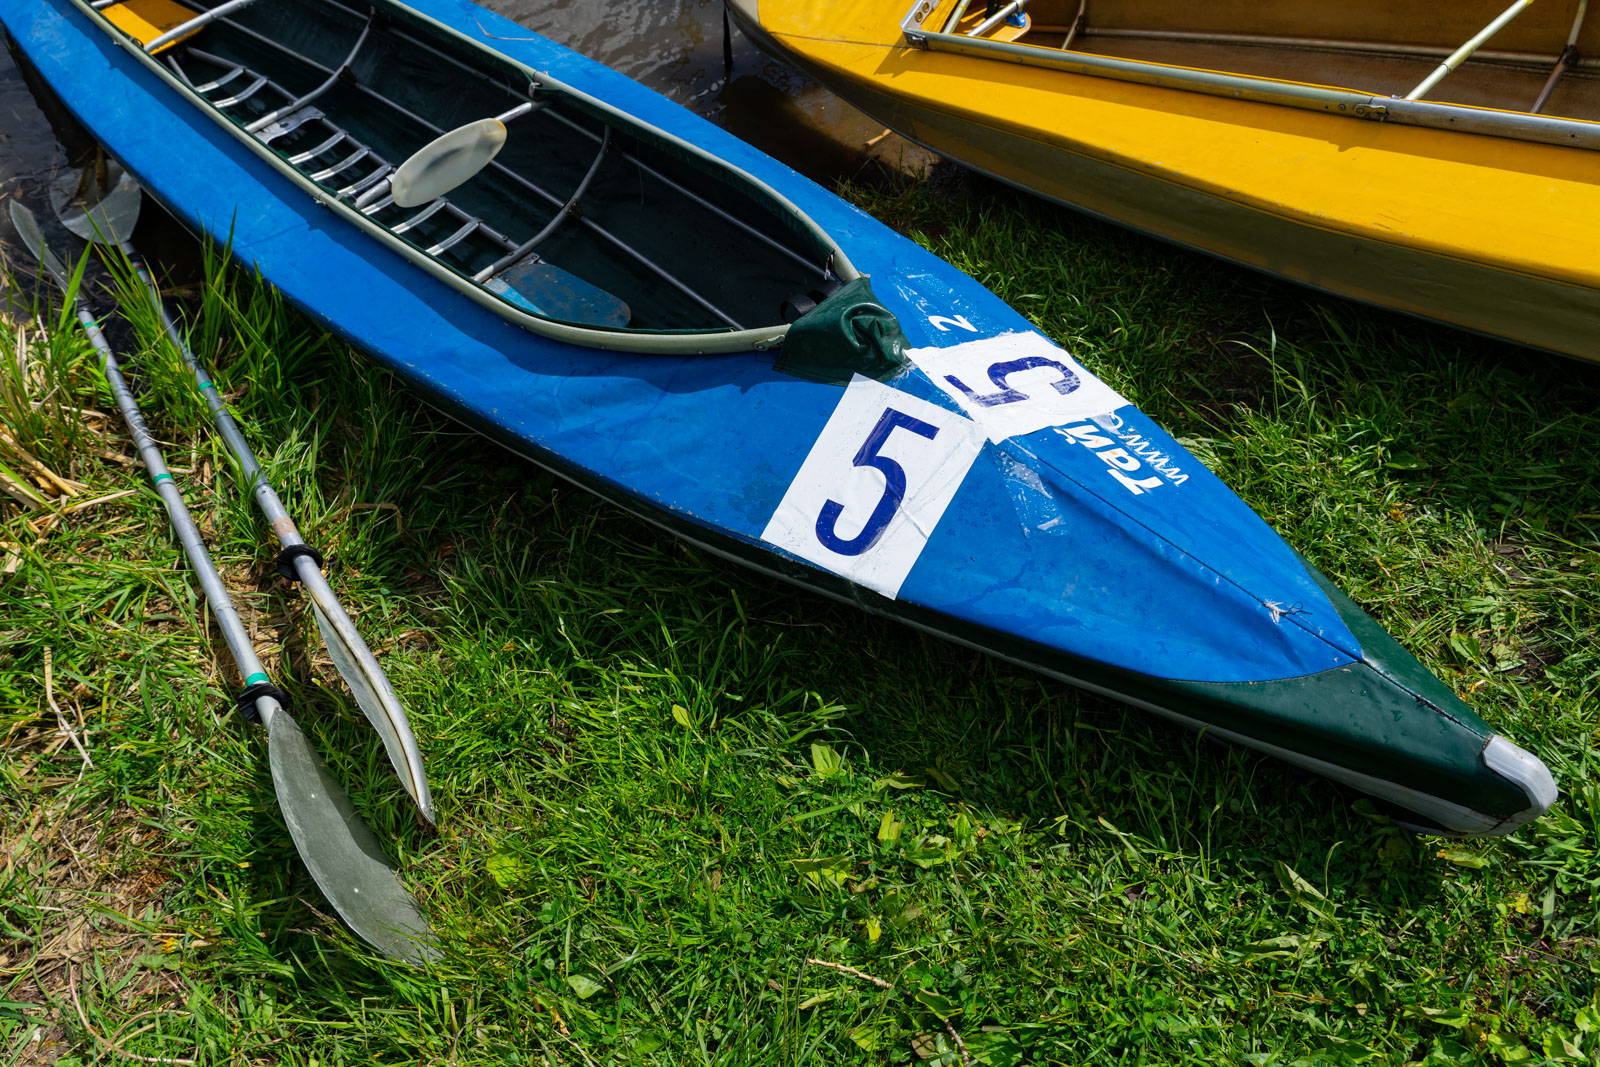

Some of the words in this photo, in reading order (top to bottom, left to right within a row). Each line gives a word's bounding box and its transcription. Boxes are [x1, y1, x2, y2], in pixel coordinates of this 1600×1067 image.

[943, 356, 1081, 408] 5
[815, 406, 940, 556] 5
[1053, 419, 1164, 495] Тай
